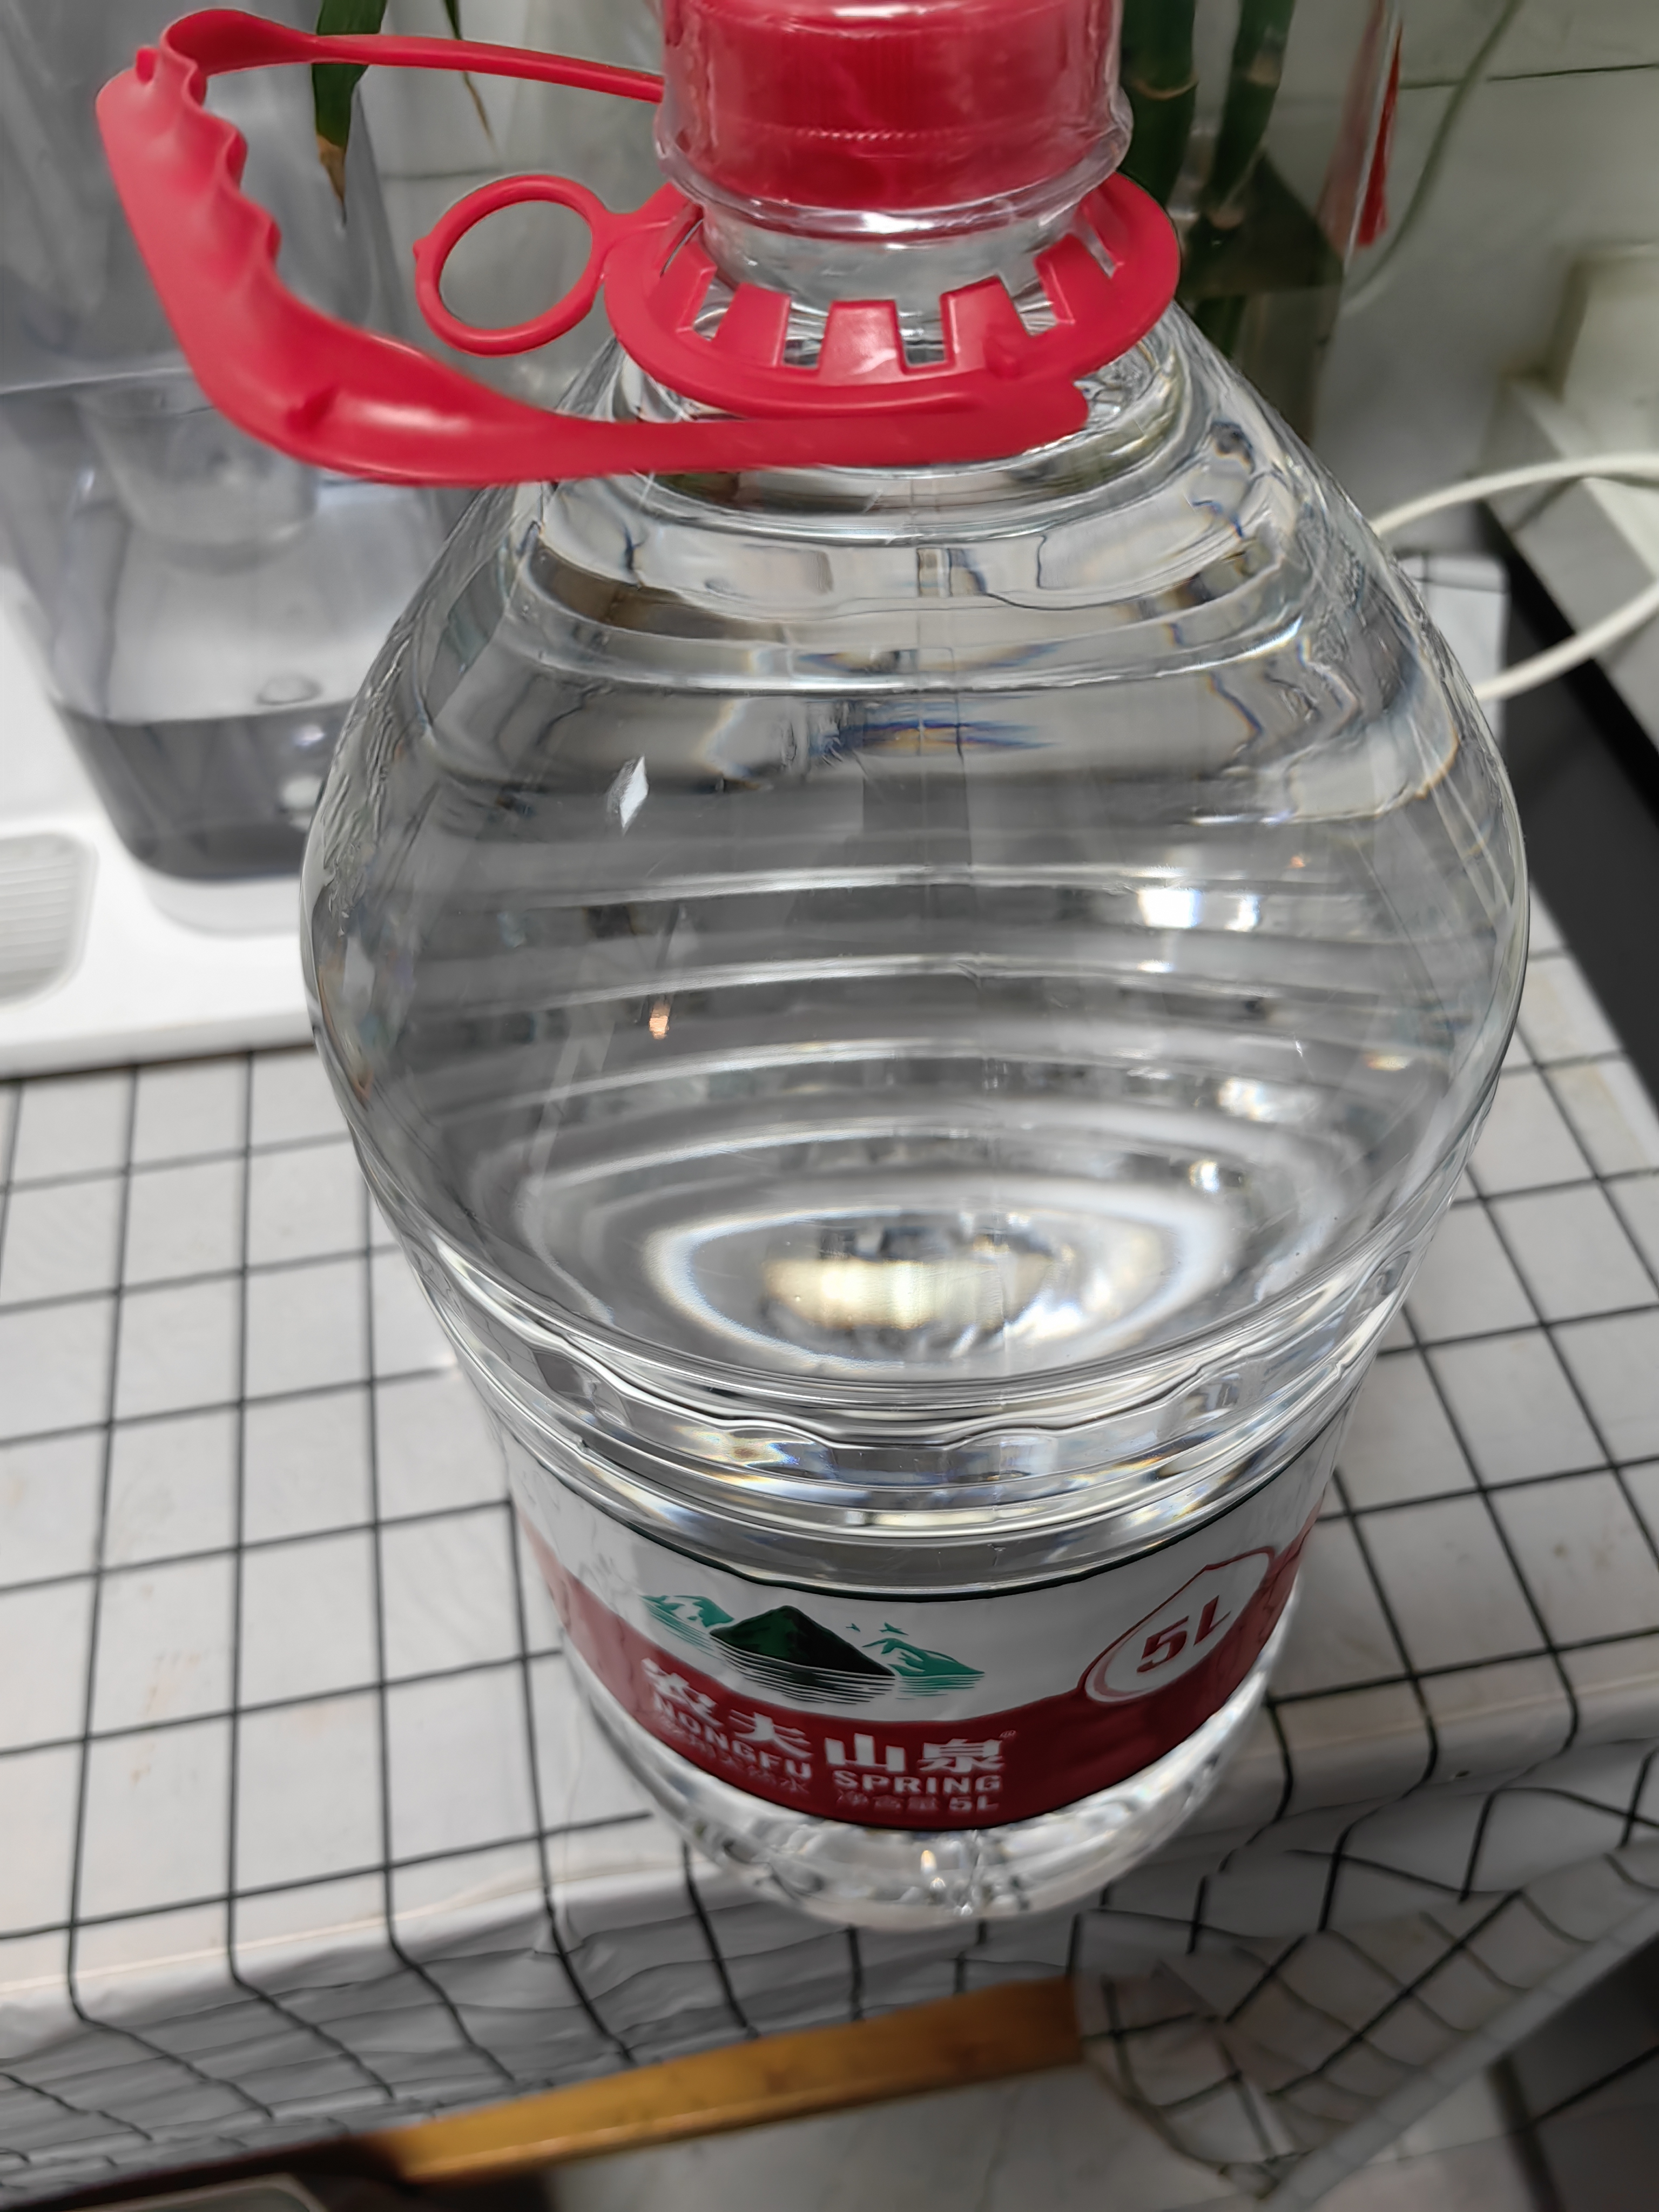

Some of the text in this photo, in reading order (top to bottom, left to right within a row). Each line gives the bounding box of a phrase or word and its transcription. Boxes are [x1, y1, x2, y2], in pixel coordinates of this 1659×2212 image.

[1136, 1594, 1231, 1673] 5L
[654, 1691, 1002, 1794] NONGFU SPRING
[948, 1794, 1000, 1811] 5L
